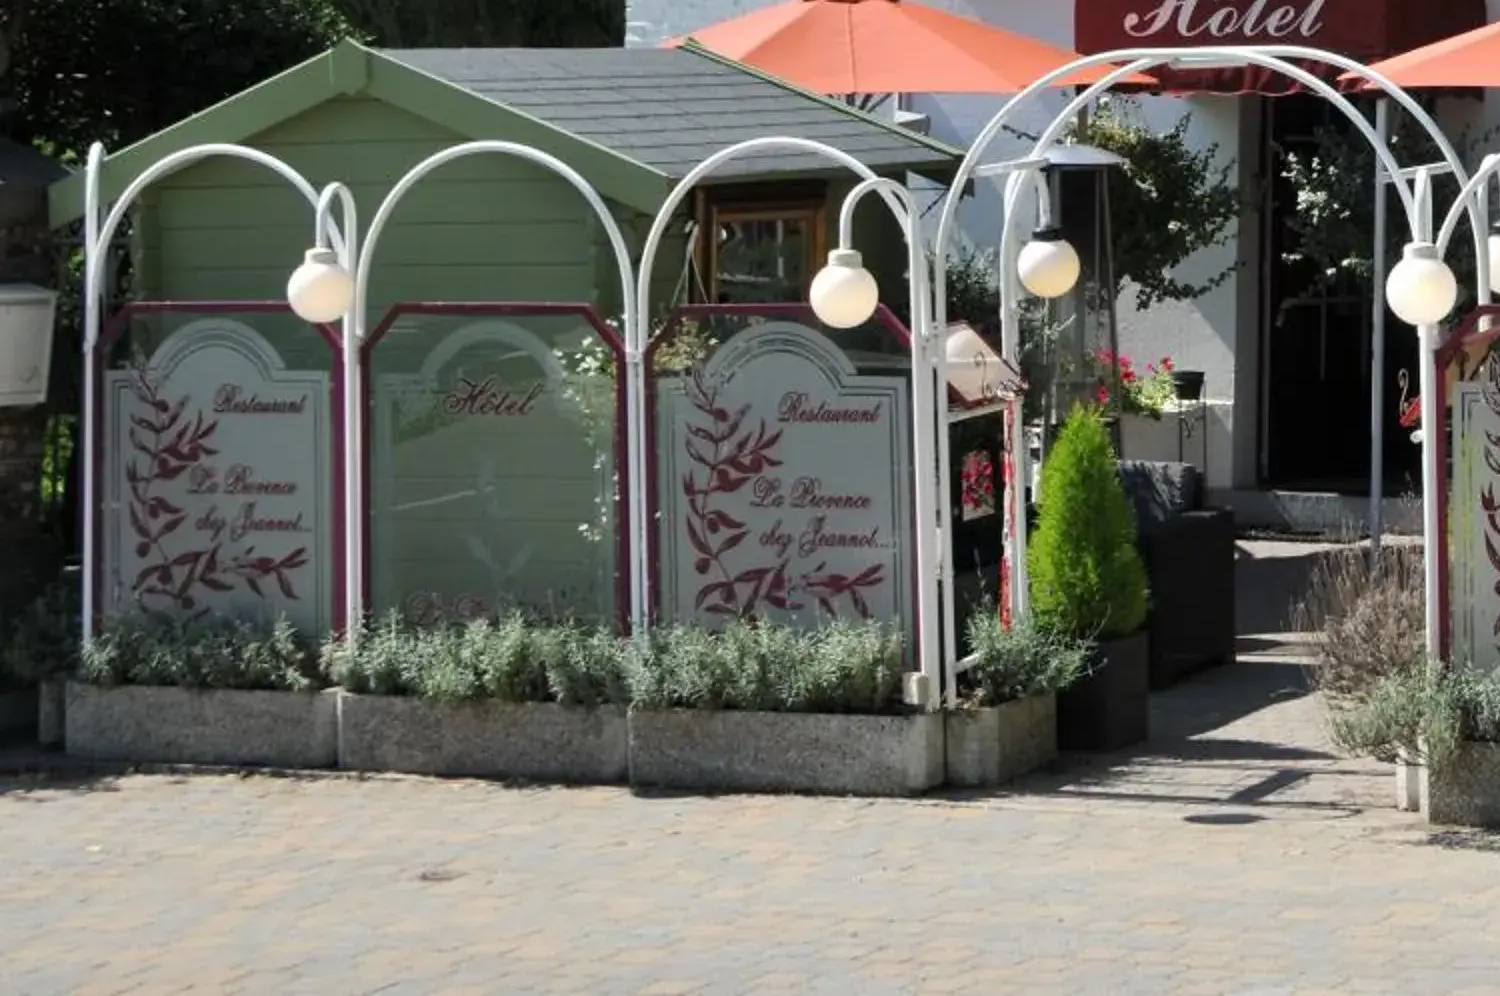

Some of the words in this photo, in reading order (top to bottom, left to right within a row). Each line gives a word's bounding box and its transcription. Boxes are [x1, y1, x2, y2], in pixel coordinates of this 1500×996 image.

[213, 383, 308, 414] Restaurant
[440, 375, 546, 417] Hôtel
[777, 391, 884, 424] Restaurant
[186, 463, 220, 495] La
[222, 463, 299, 496] Provence
[749, 476, 786, 507] La
[790, 476, 872, 510] Provence
